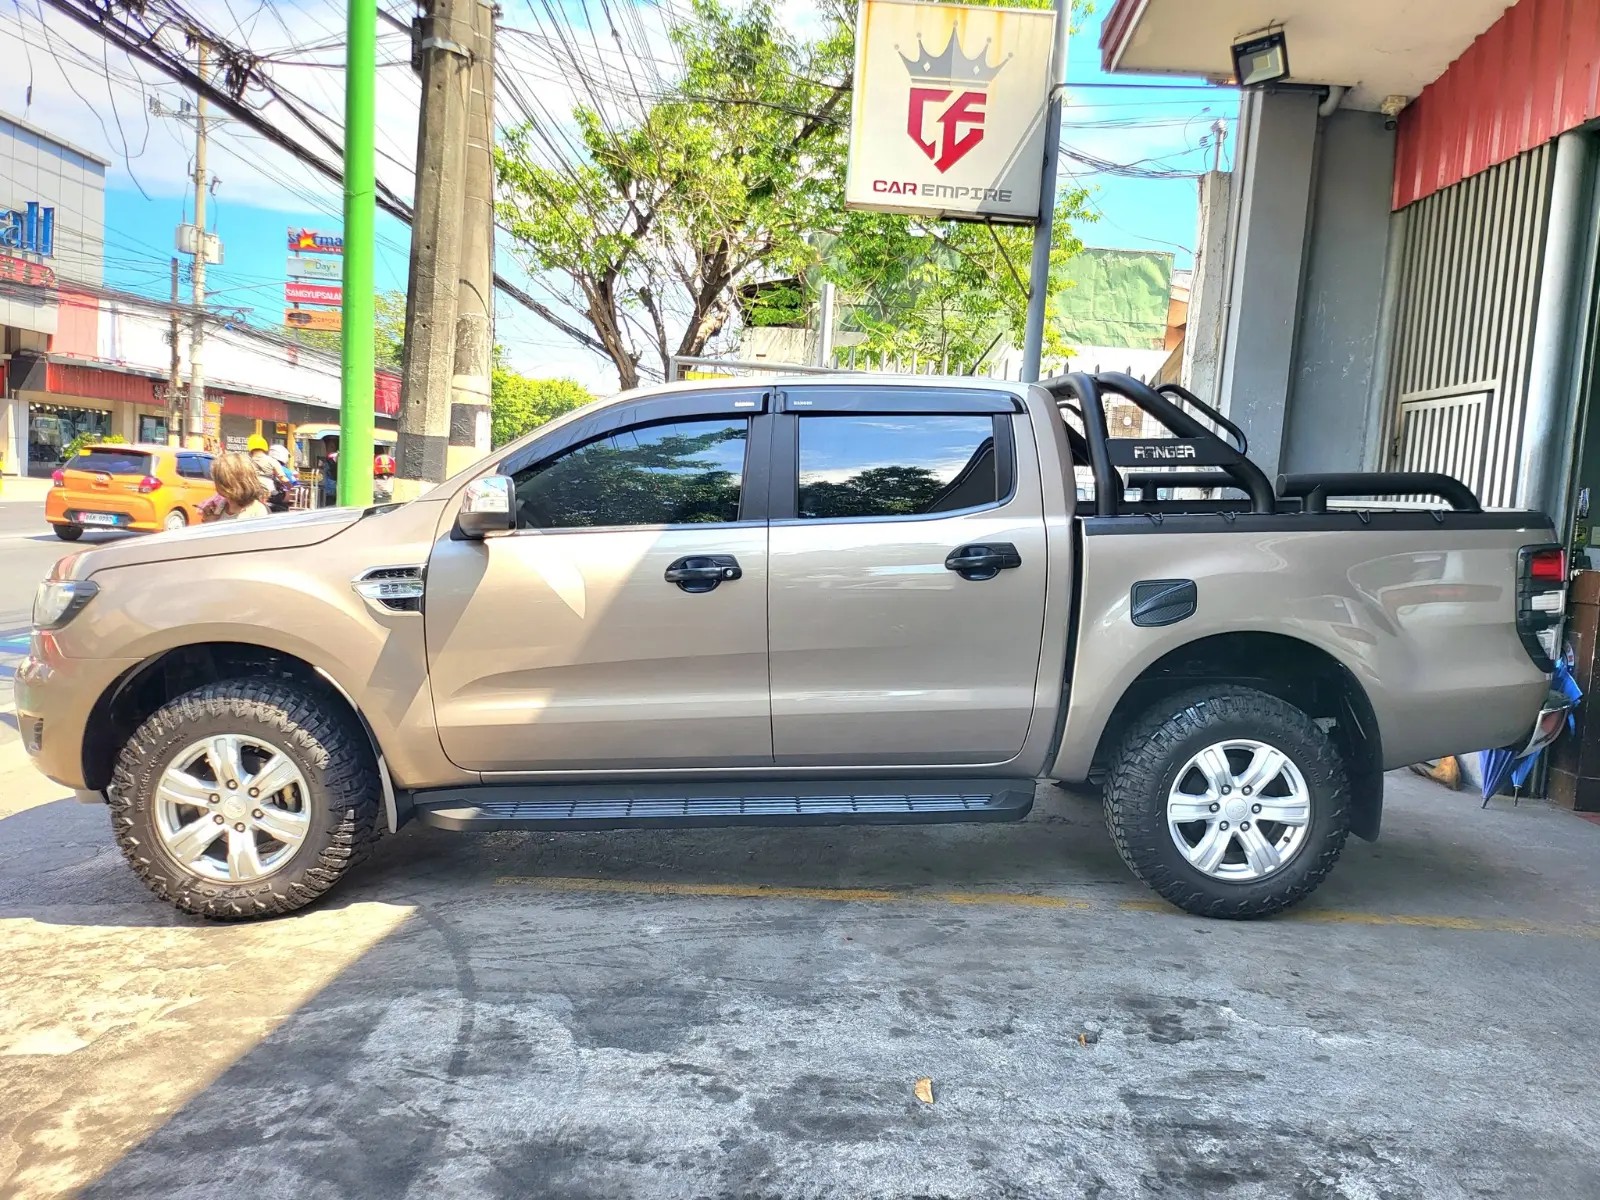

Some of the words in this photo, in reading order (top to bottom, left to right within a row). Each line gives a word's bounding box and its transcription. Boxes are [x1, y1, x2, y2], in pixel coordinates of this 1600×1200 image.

[873, 180, 917, 196] CAR
[921, 183, 1013, 203] EMPIRE
[1134, 444, 1196, 459] RANGER
